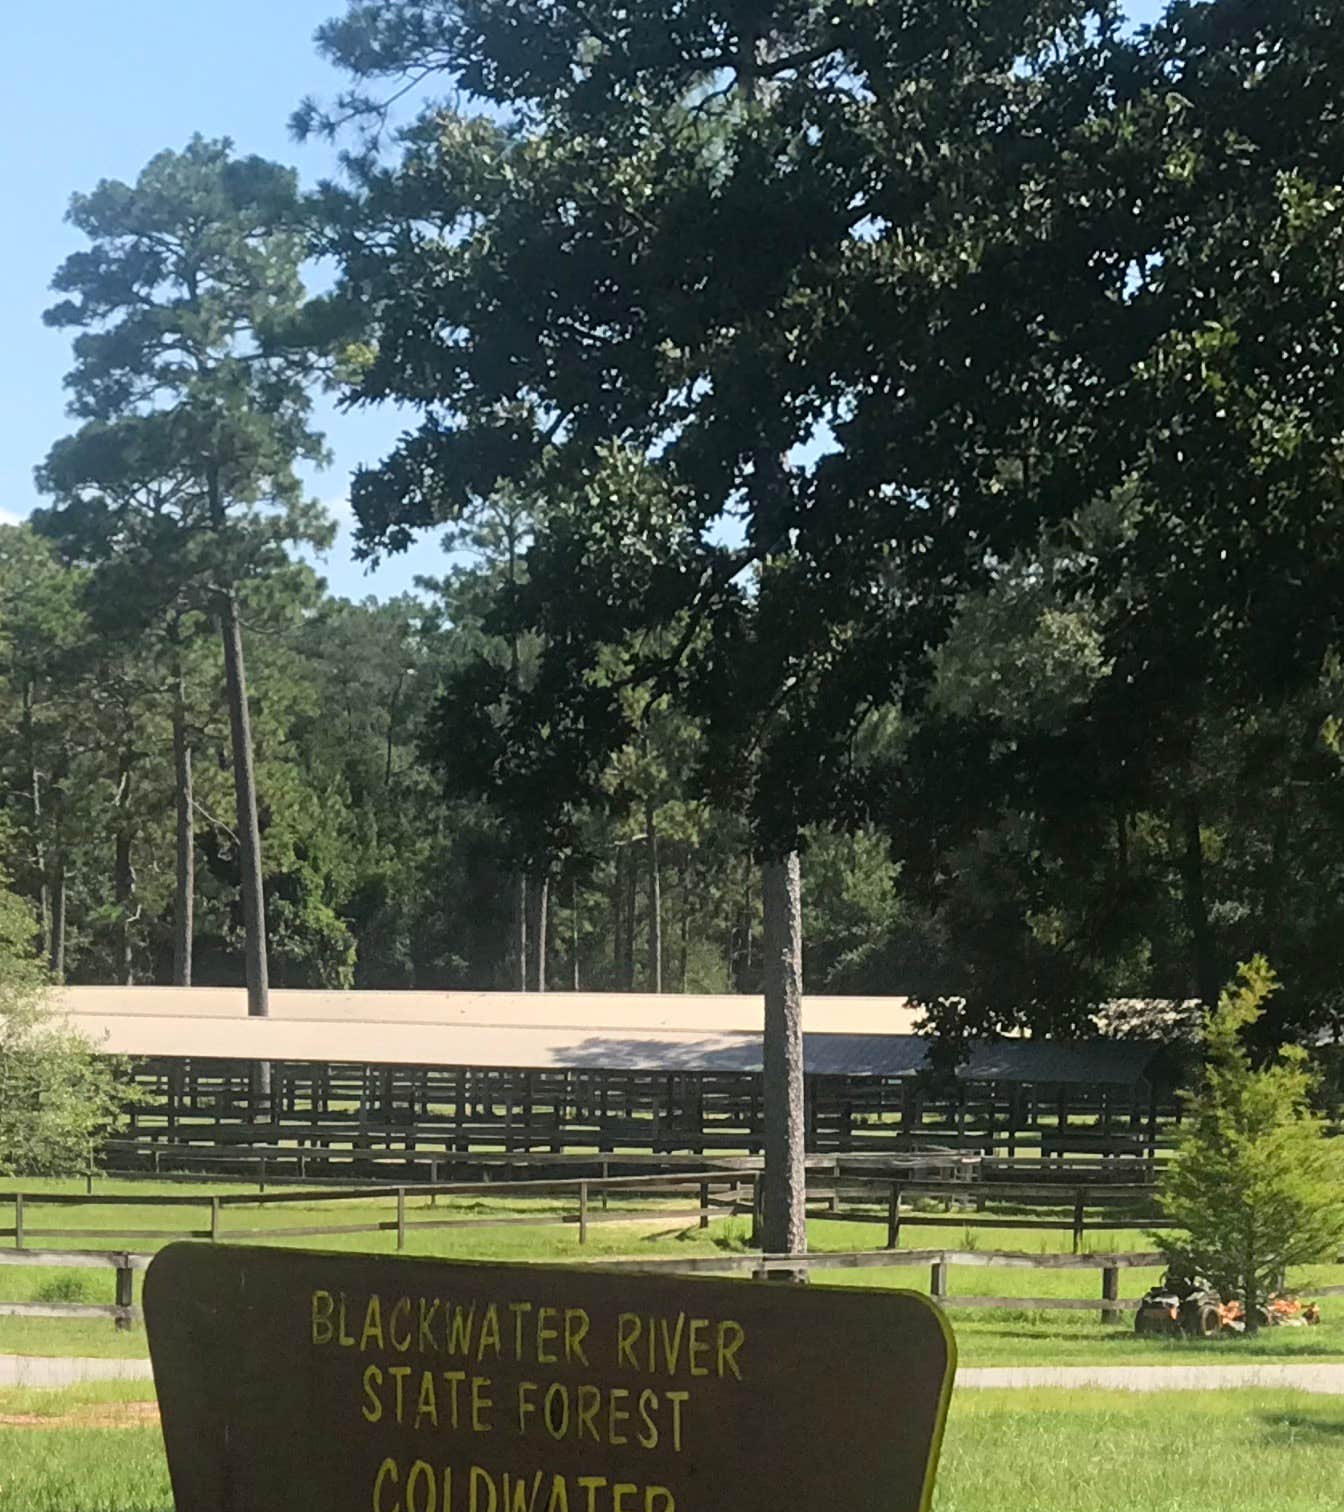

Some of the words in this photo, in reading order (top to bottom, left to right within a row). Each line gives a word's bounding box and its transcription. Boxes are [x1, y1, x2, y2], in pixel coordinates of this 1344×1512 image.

[311, 1290, 589, 1365] BLACKWATER
[617, 1313, 745, 1380] RIVER
[362, 1365, 492, 1432] STATE
[518, 1382, 690, 1451] FOREST
